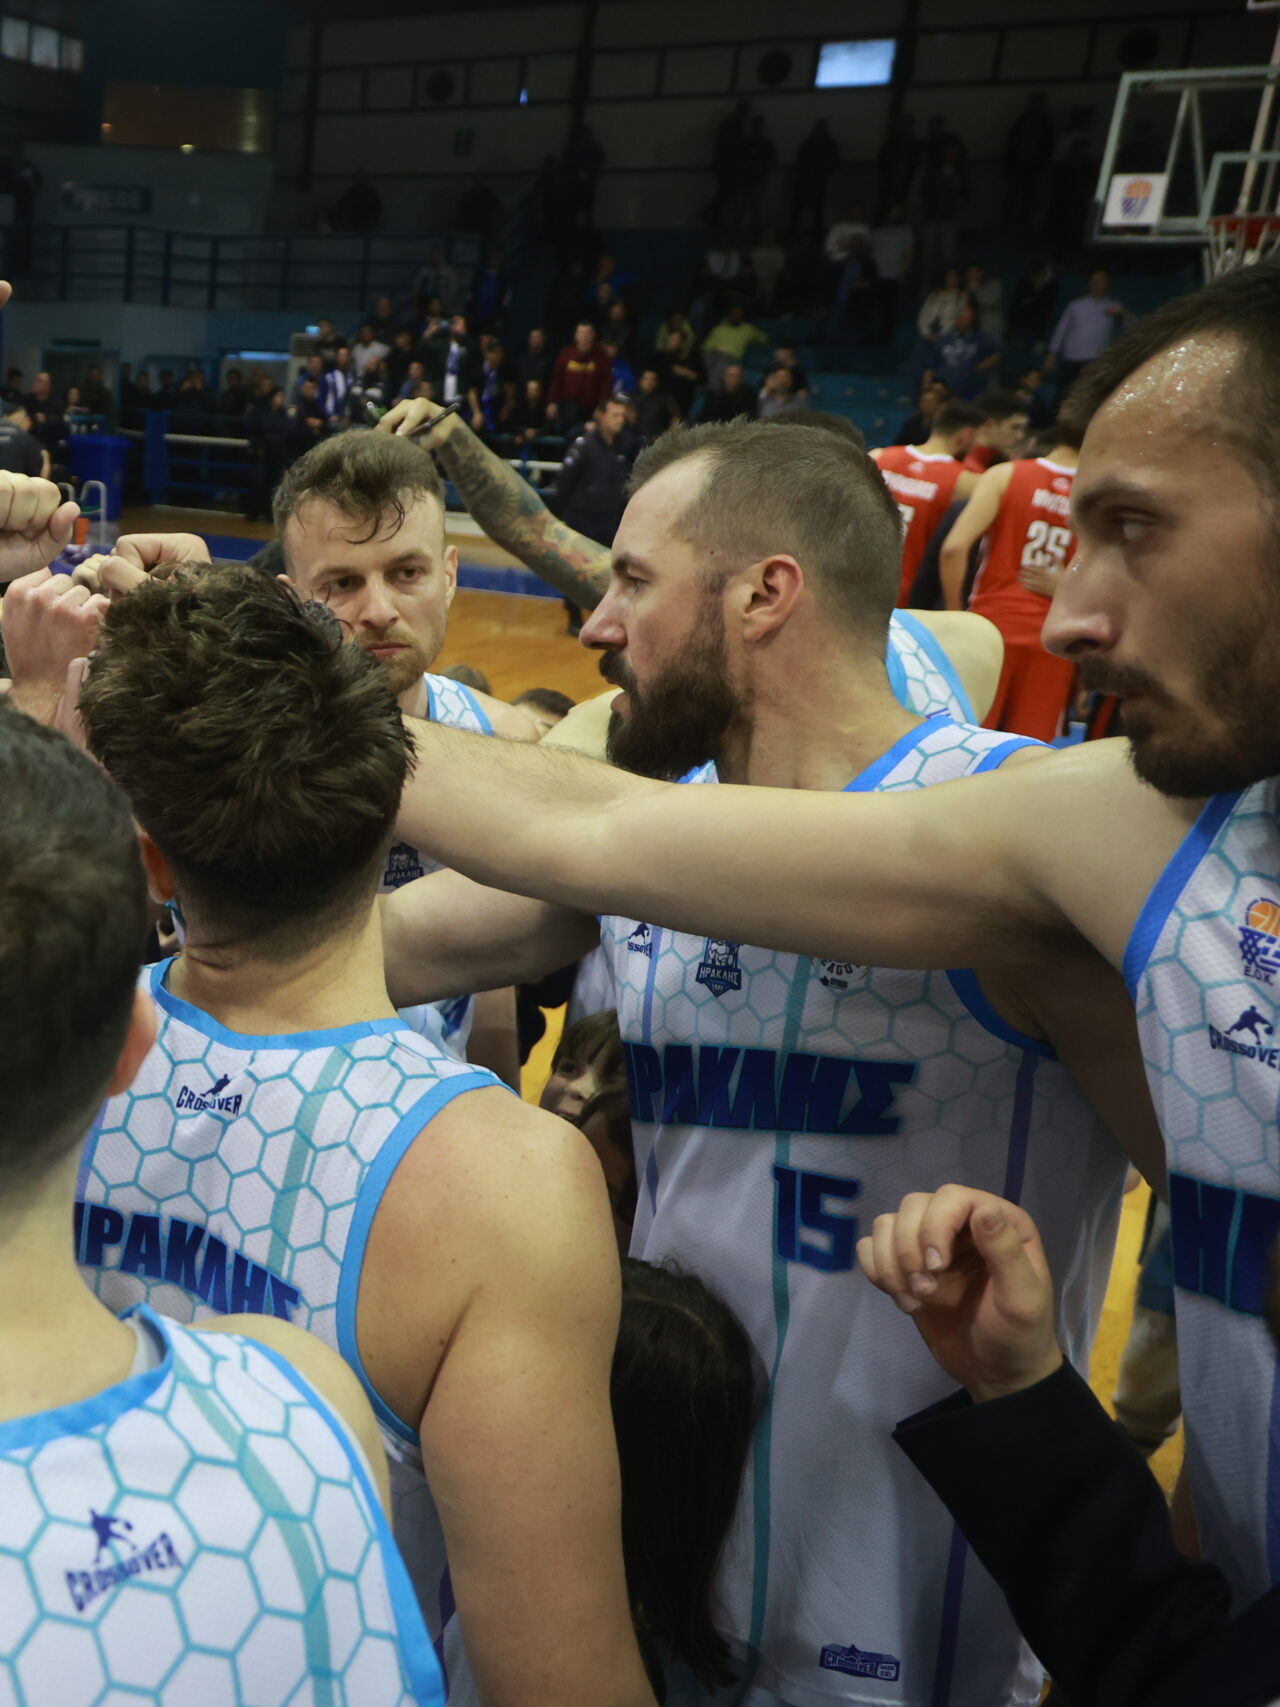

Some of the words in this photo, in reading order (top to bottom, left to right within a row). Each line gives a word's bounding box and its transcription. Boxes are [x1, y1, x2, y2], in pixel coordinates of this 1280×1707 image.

[1021, 519, 1072, 572] 25
[1209, 1023, 1280, 1072] CROSSOVE
[773, 1163, 861, 1272] 15
